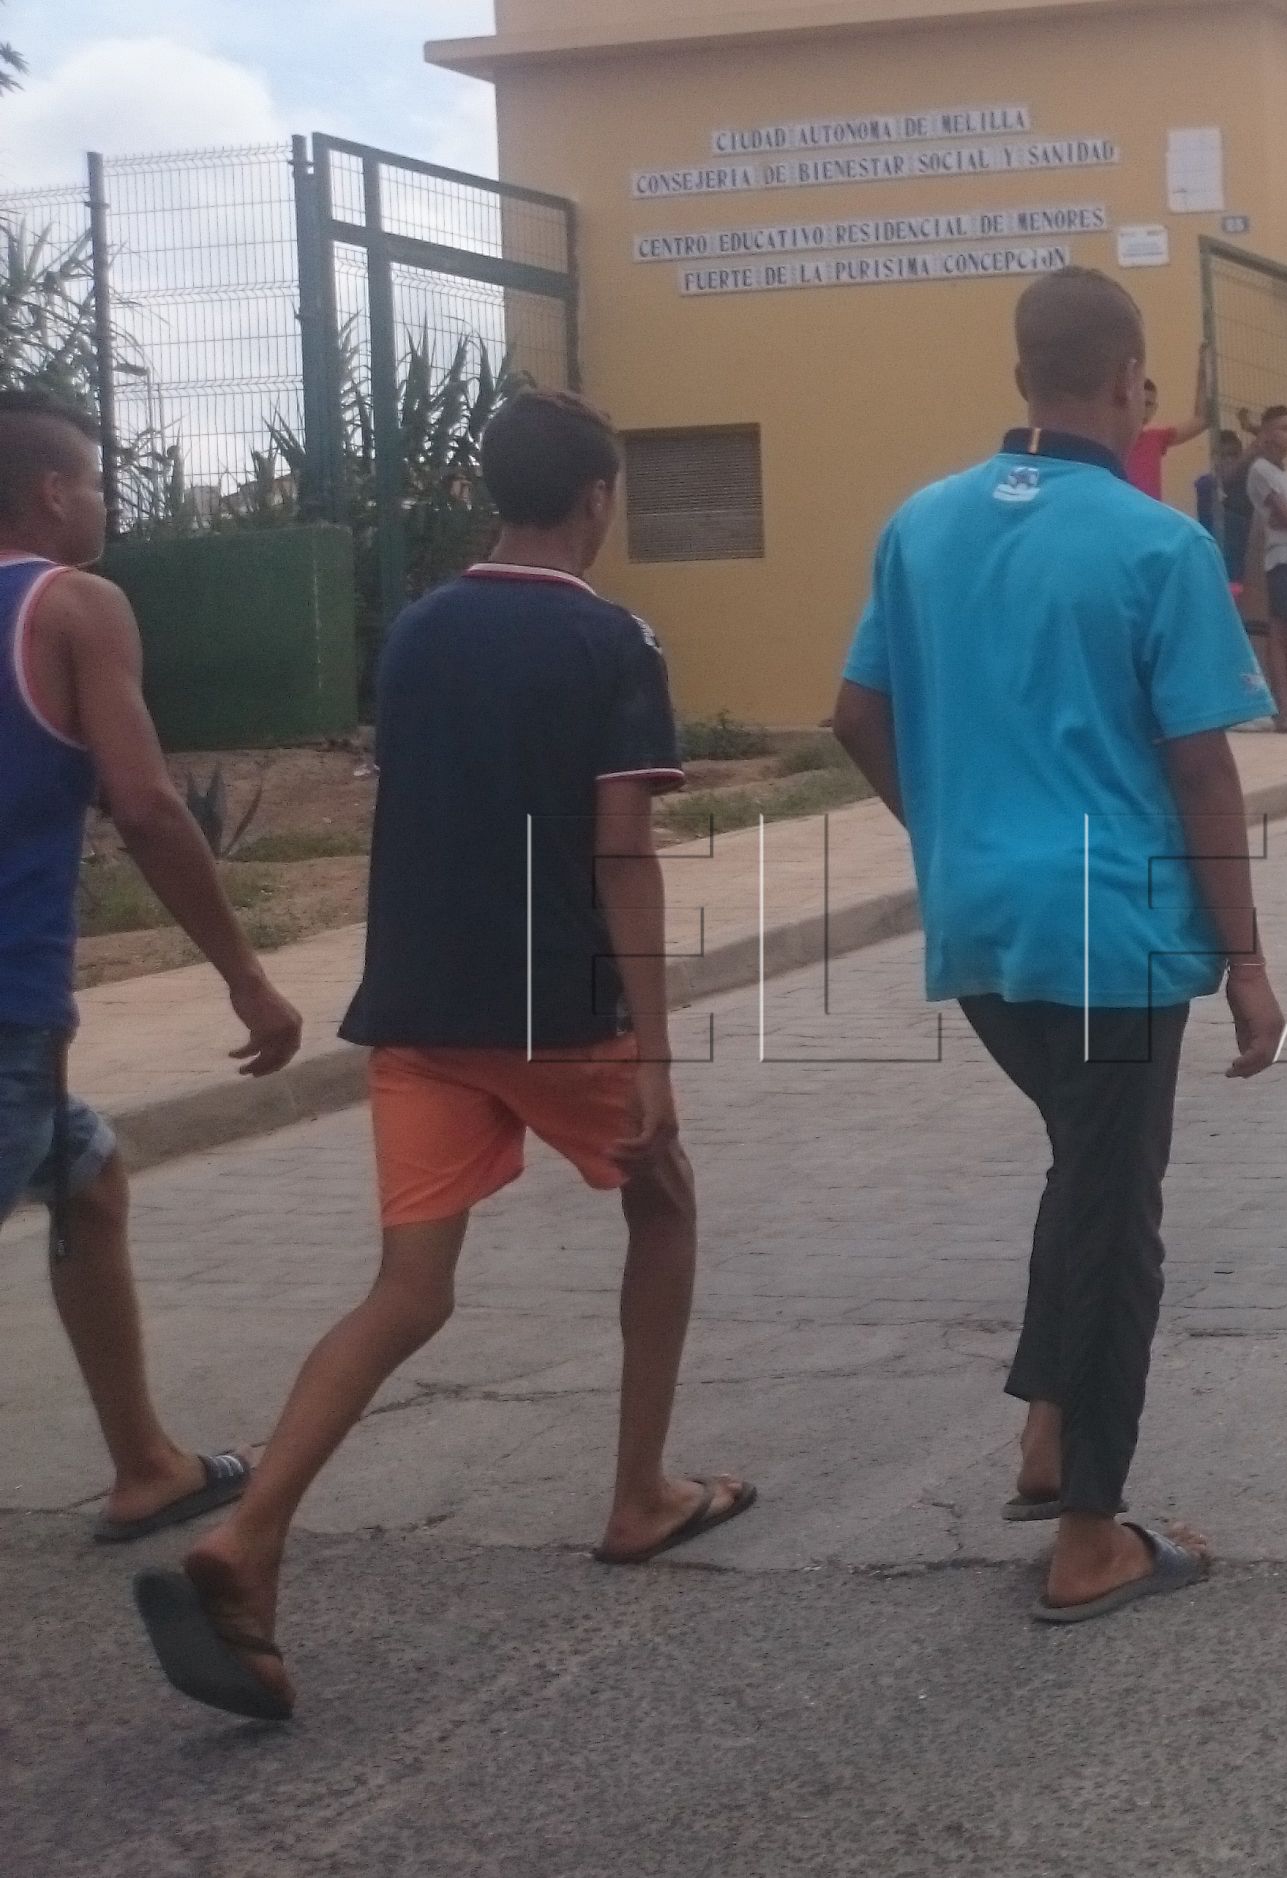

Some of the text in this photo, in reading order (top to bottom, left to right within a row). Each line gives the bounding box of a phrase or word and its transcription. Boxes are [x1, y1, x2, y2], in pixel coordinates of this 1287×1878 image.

[716, 109, 1026, 151] CIUDAD AUTONOMA DE MELILLA
[636, 140, 1115, 194] CONSEJERIA DE BIENESTAR SOCIAL Y SANIDAD
[638, 207, 1106, 259] CENTRO EDUCATIVO RESIDENCIAL DE MENORES
[684, 268, 753, 292] FUERTE
[764, 264, 789, 286] DE
[800, 262, 824, 284] LA
[835, 256, 930, 281] PURISIMA
